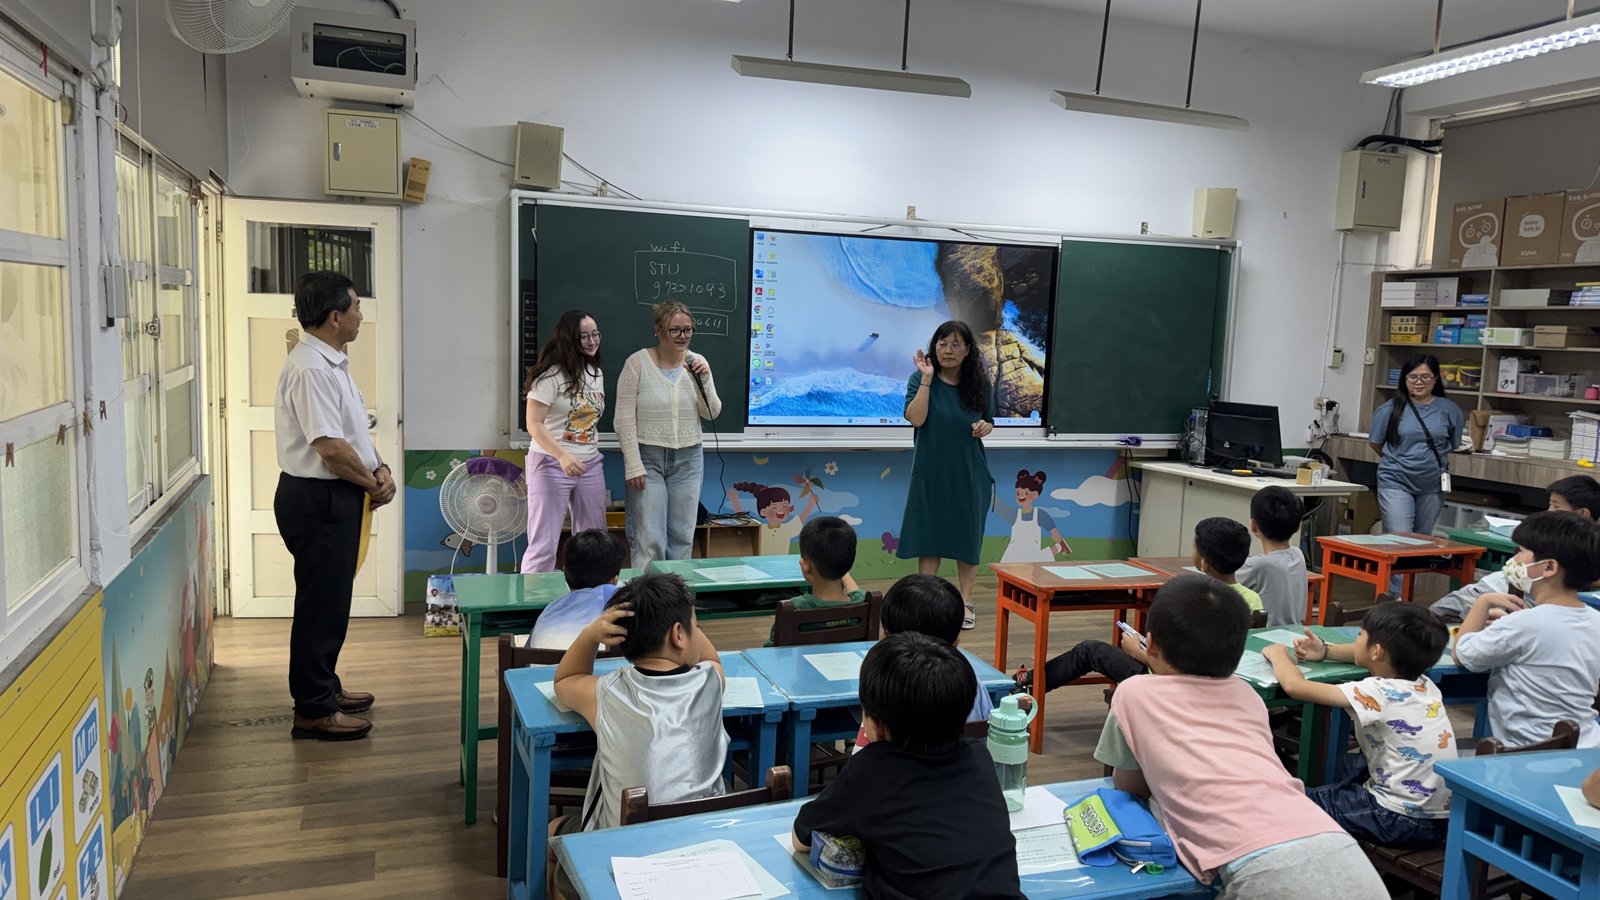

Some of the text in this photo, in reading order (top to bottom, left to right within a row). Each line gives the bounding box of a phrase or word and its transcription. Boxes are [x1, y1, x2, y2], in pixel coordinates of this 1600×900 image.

[649, 261, 680, 276] STU
[77, 721, 97, 769] Mm
[1080, 805, 1108, 837] SNOOPY
[83, 841, 100, 888] Zz
